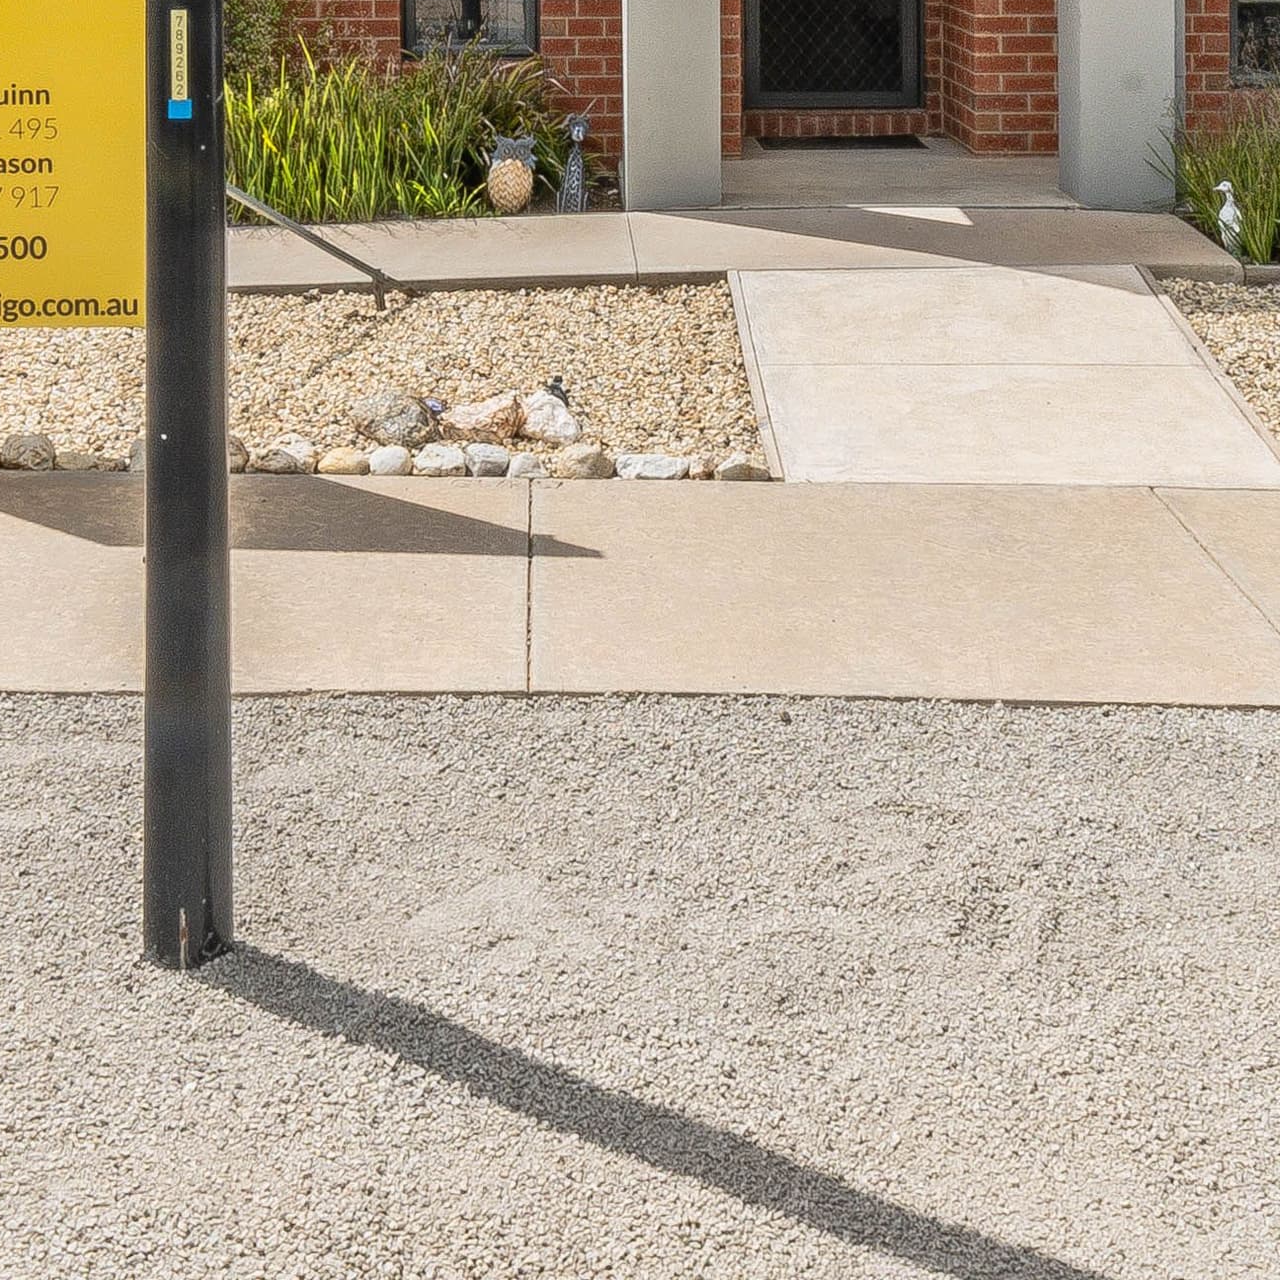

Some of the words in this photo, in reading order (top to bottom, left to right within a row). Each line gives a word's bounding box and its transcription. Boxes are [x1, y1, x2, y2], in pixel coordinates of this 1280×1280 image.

[174, 14, 185, 96] 789262
[8, 117, 58, 140] 495
[11, 186, 59, 209] 917
